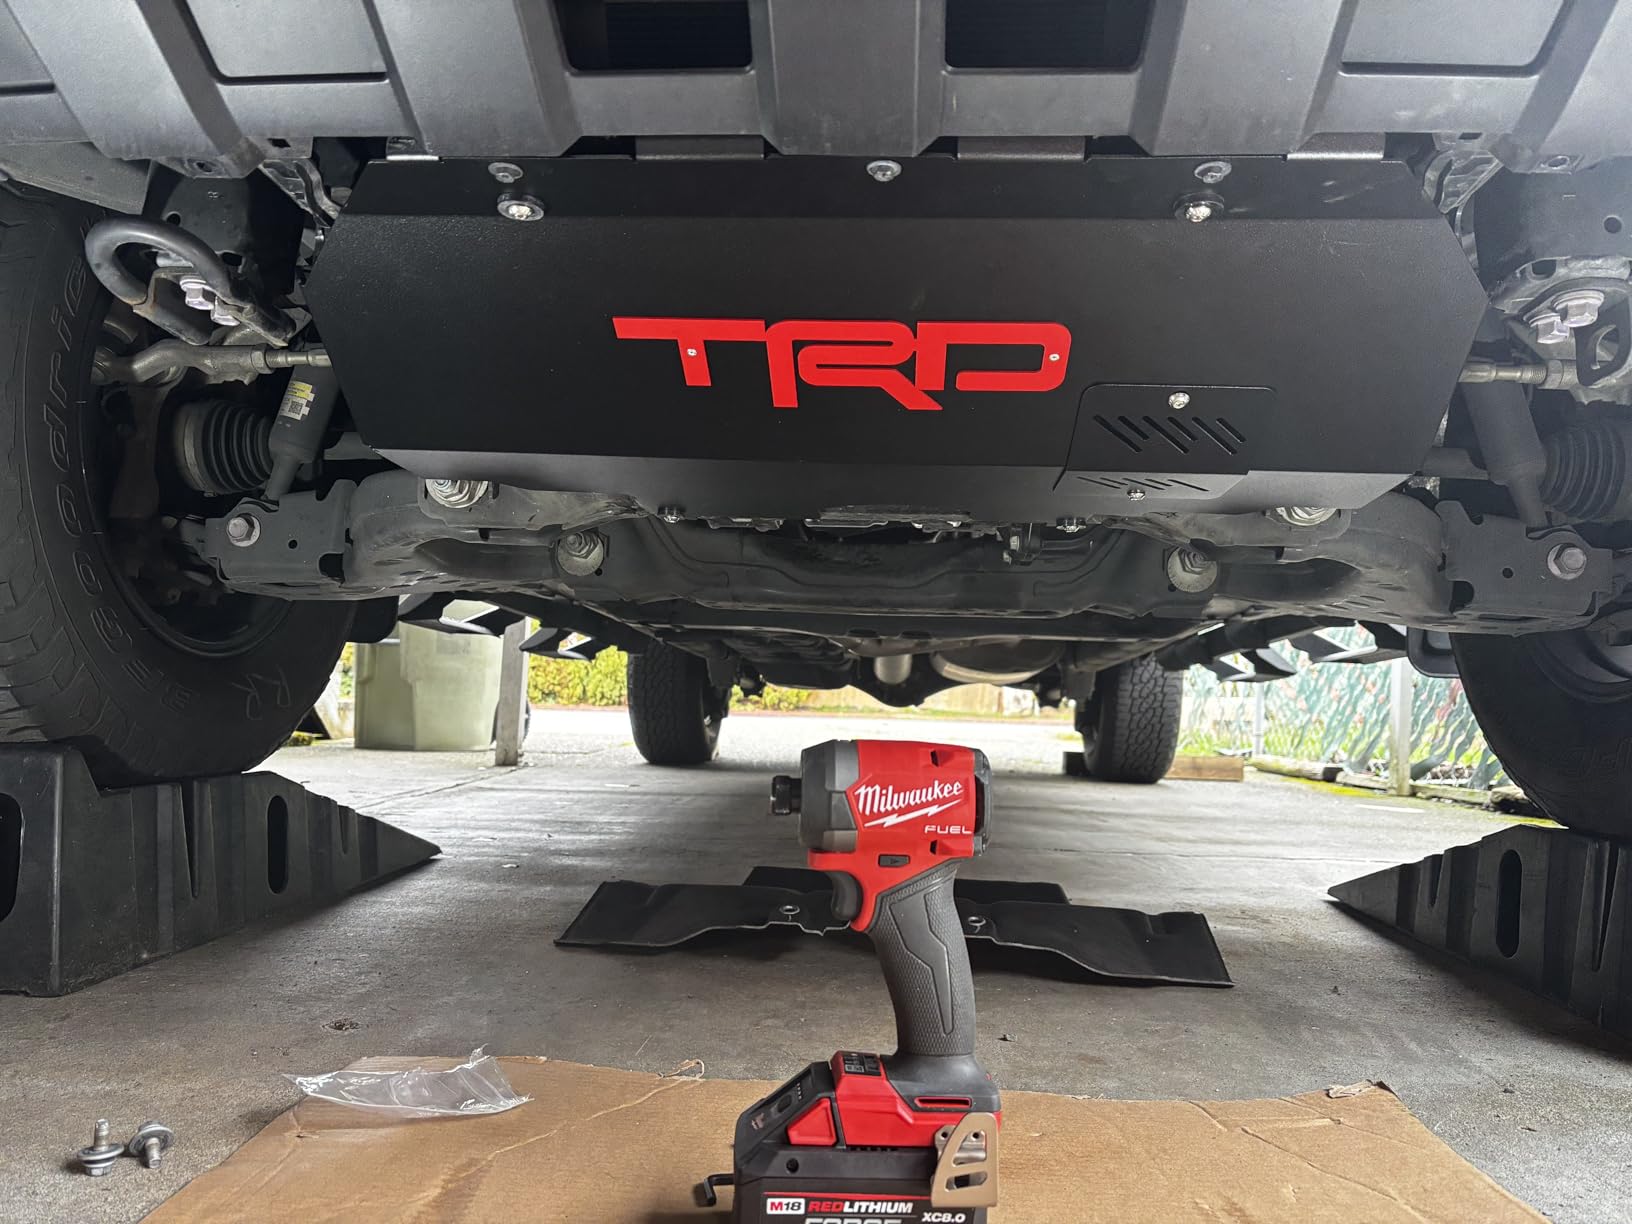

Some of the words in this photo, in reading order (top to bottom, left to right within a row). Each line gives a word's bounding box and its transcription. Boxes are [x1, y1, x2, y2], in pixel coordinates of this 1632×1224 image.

[612, 316, 1072, 411] TRD
[855, 780, 964, 816] Milwaukee
[924, 825, 972, 834] FUEL
[770, 1201, 802, 1211] M18
[808, 1201, 914, 1214] REDLITHIUM
[921, 1212, 966, 1223] XC8.0
